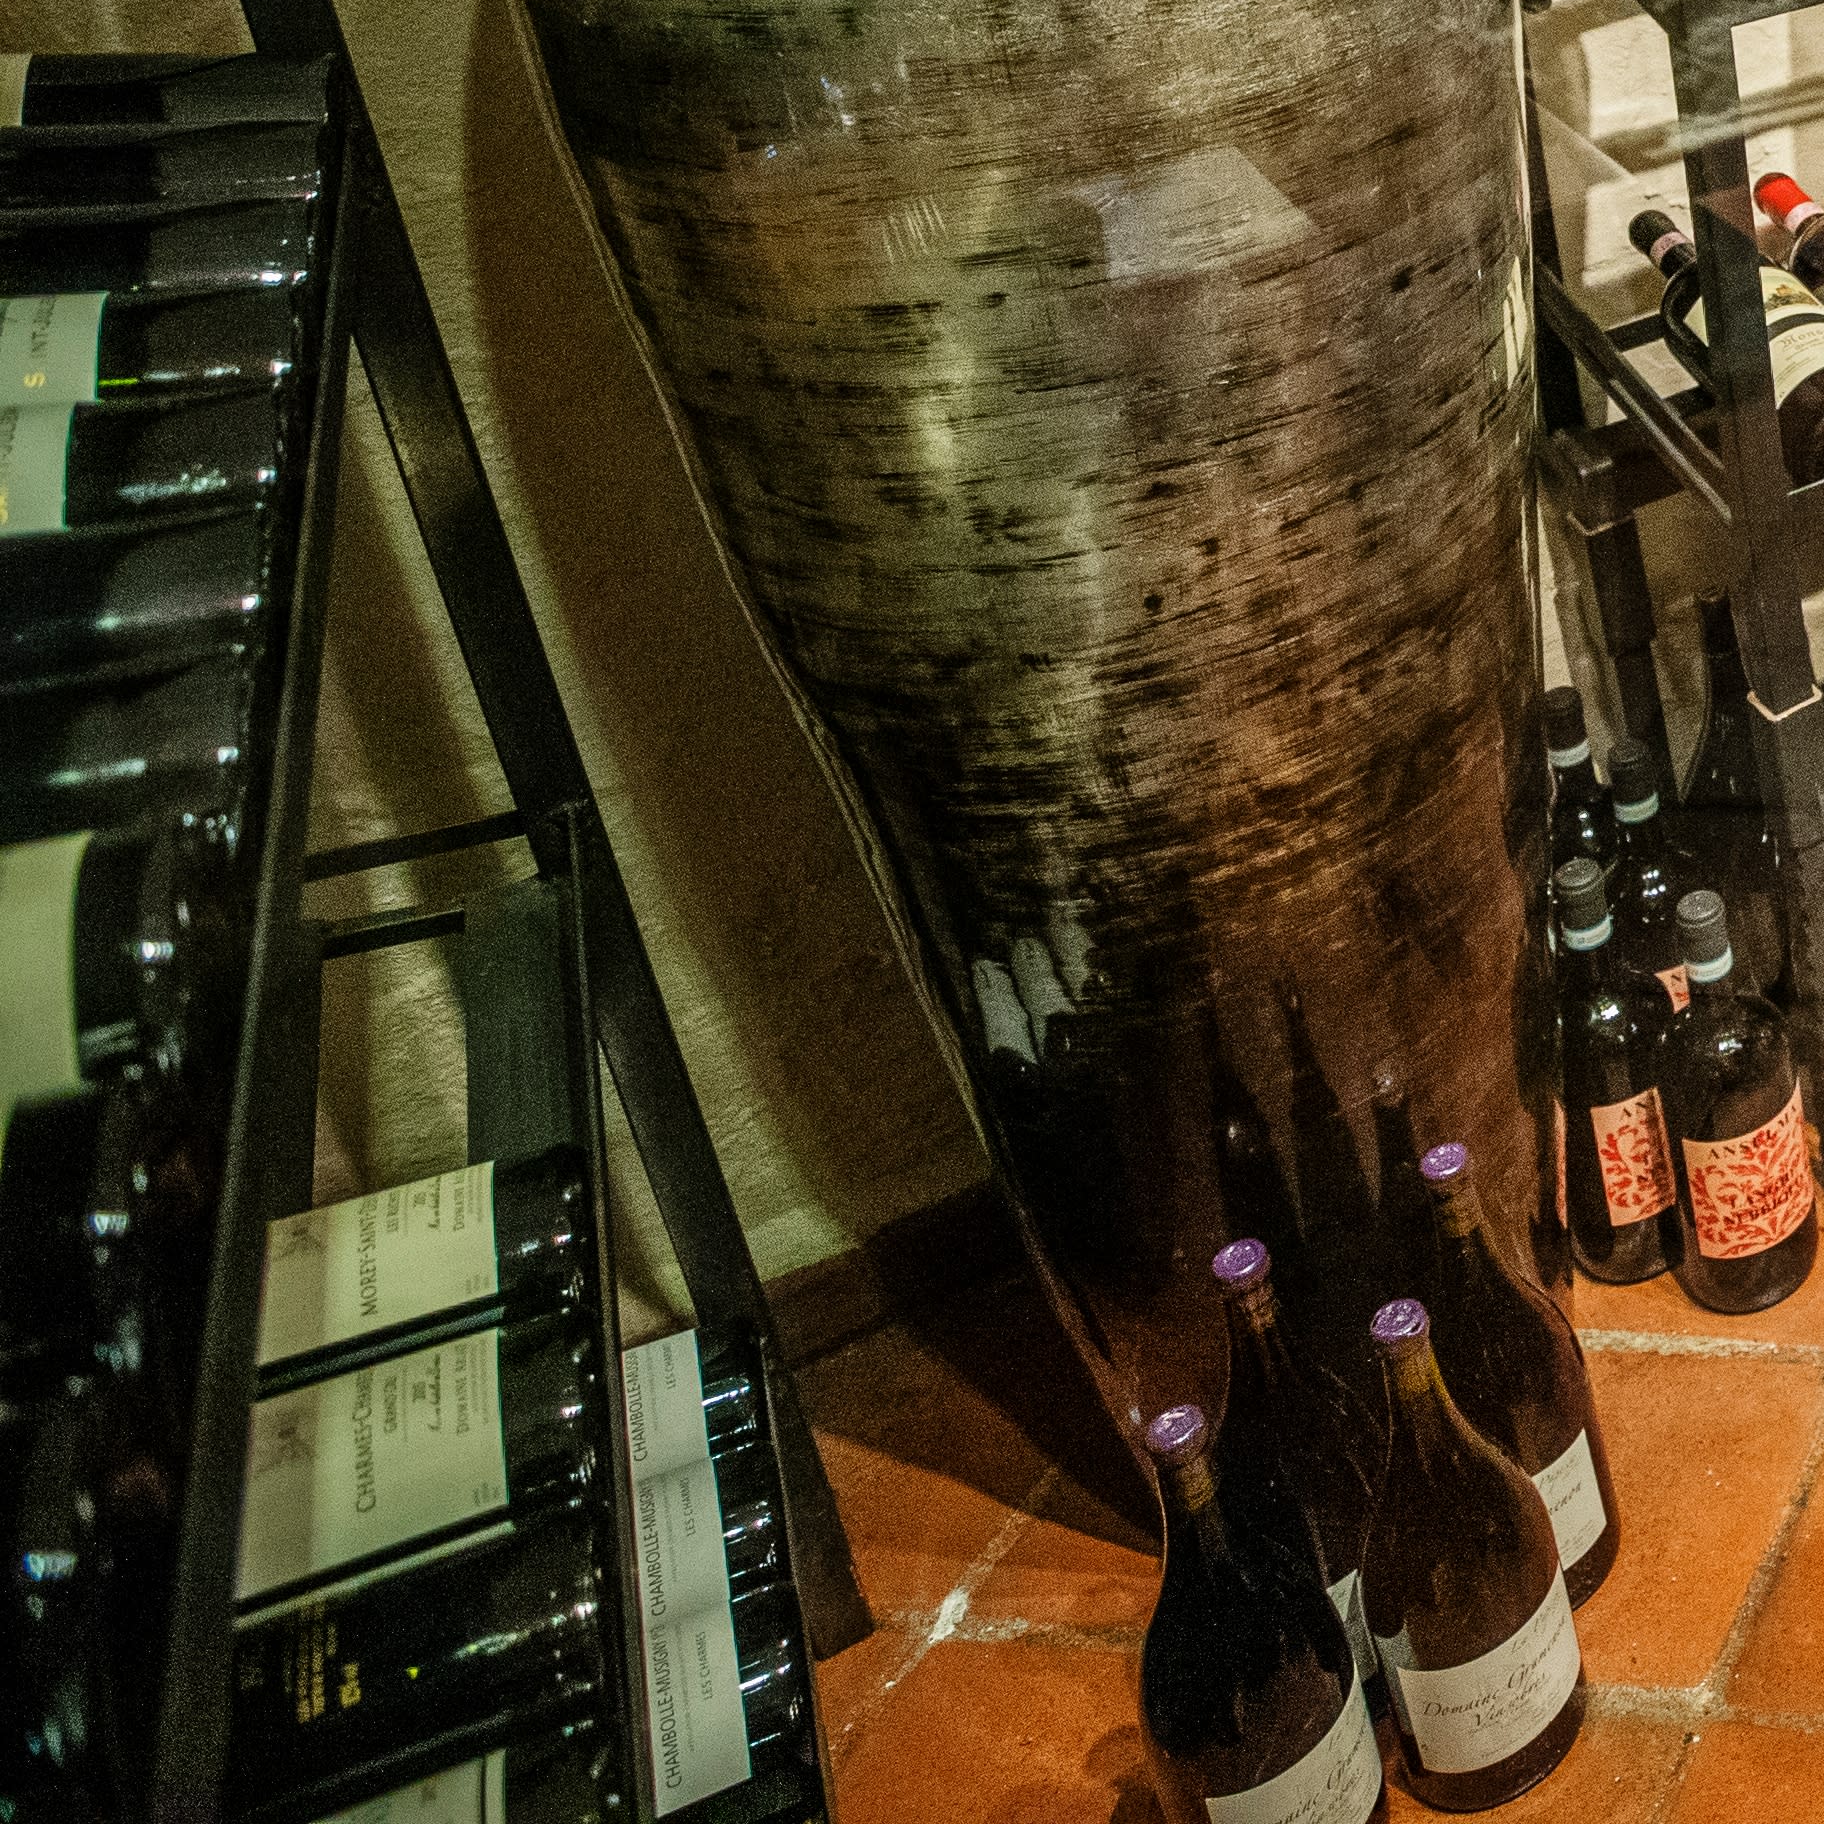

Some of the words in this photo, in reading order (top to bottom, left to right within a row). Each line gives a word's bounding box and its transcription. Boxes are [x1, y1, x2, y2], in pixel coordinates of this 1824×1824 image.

[695, 1630, 711, 1678] CHARMES
[701, 1678, 715, 1701] LES
[1423, 1688, 1500, 1718] Domaine
